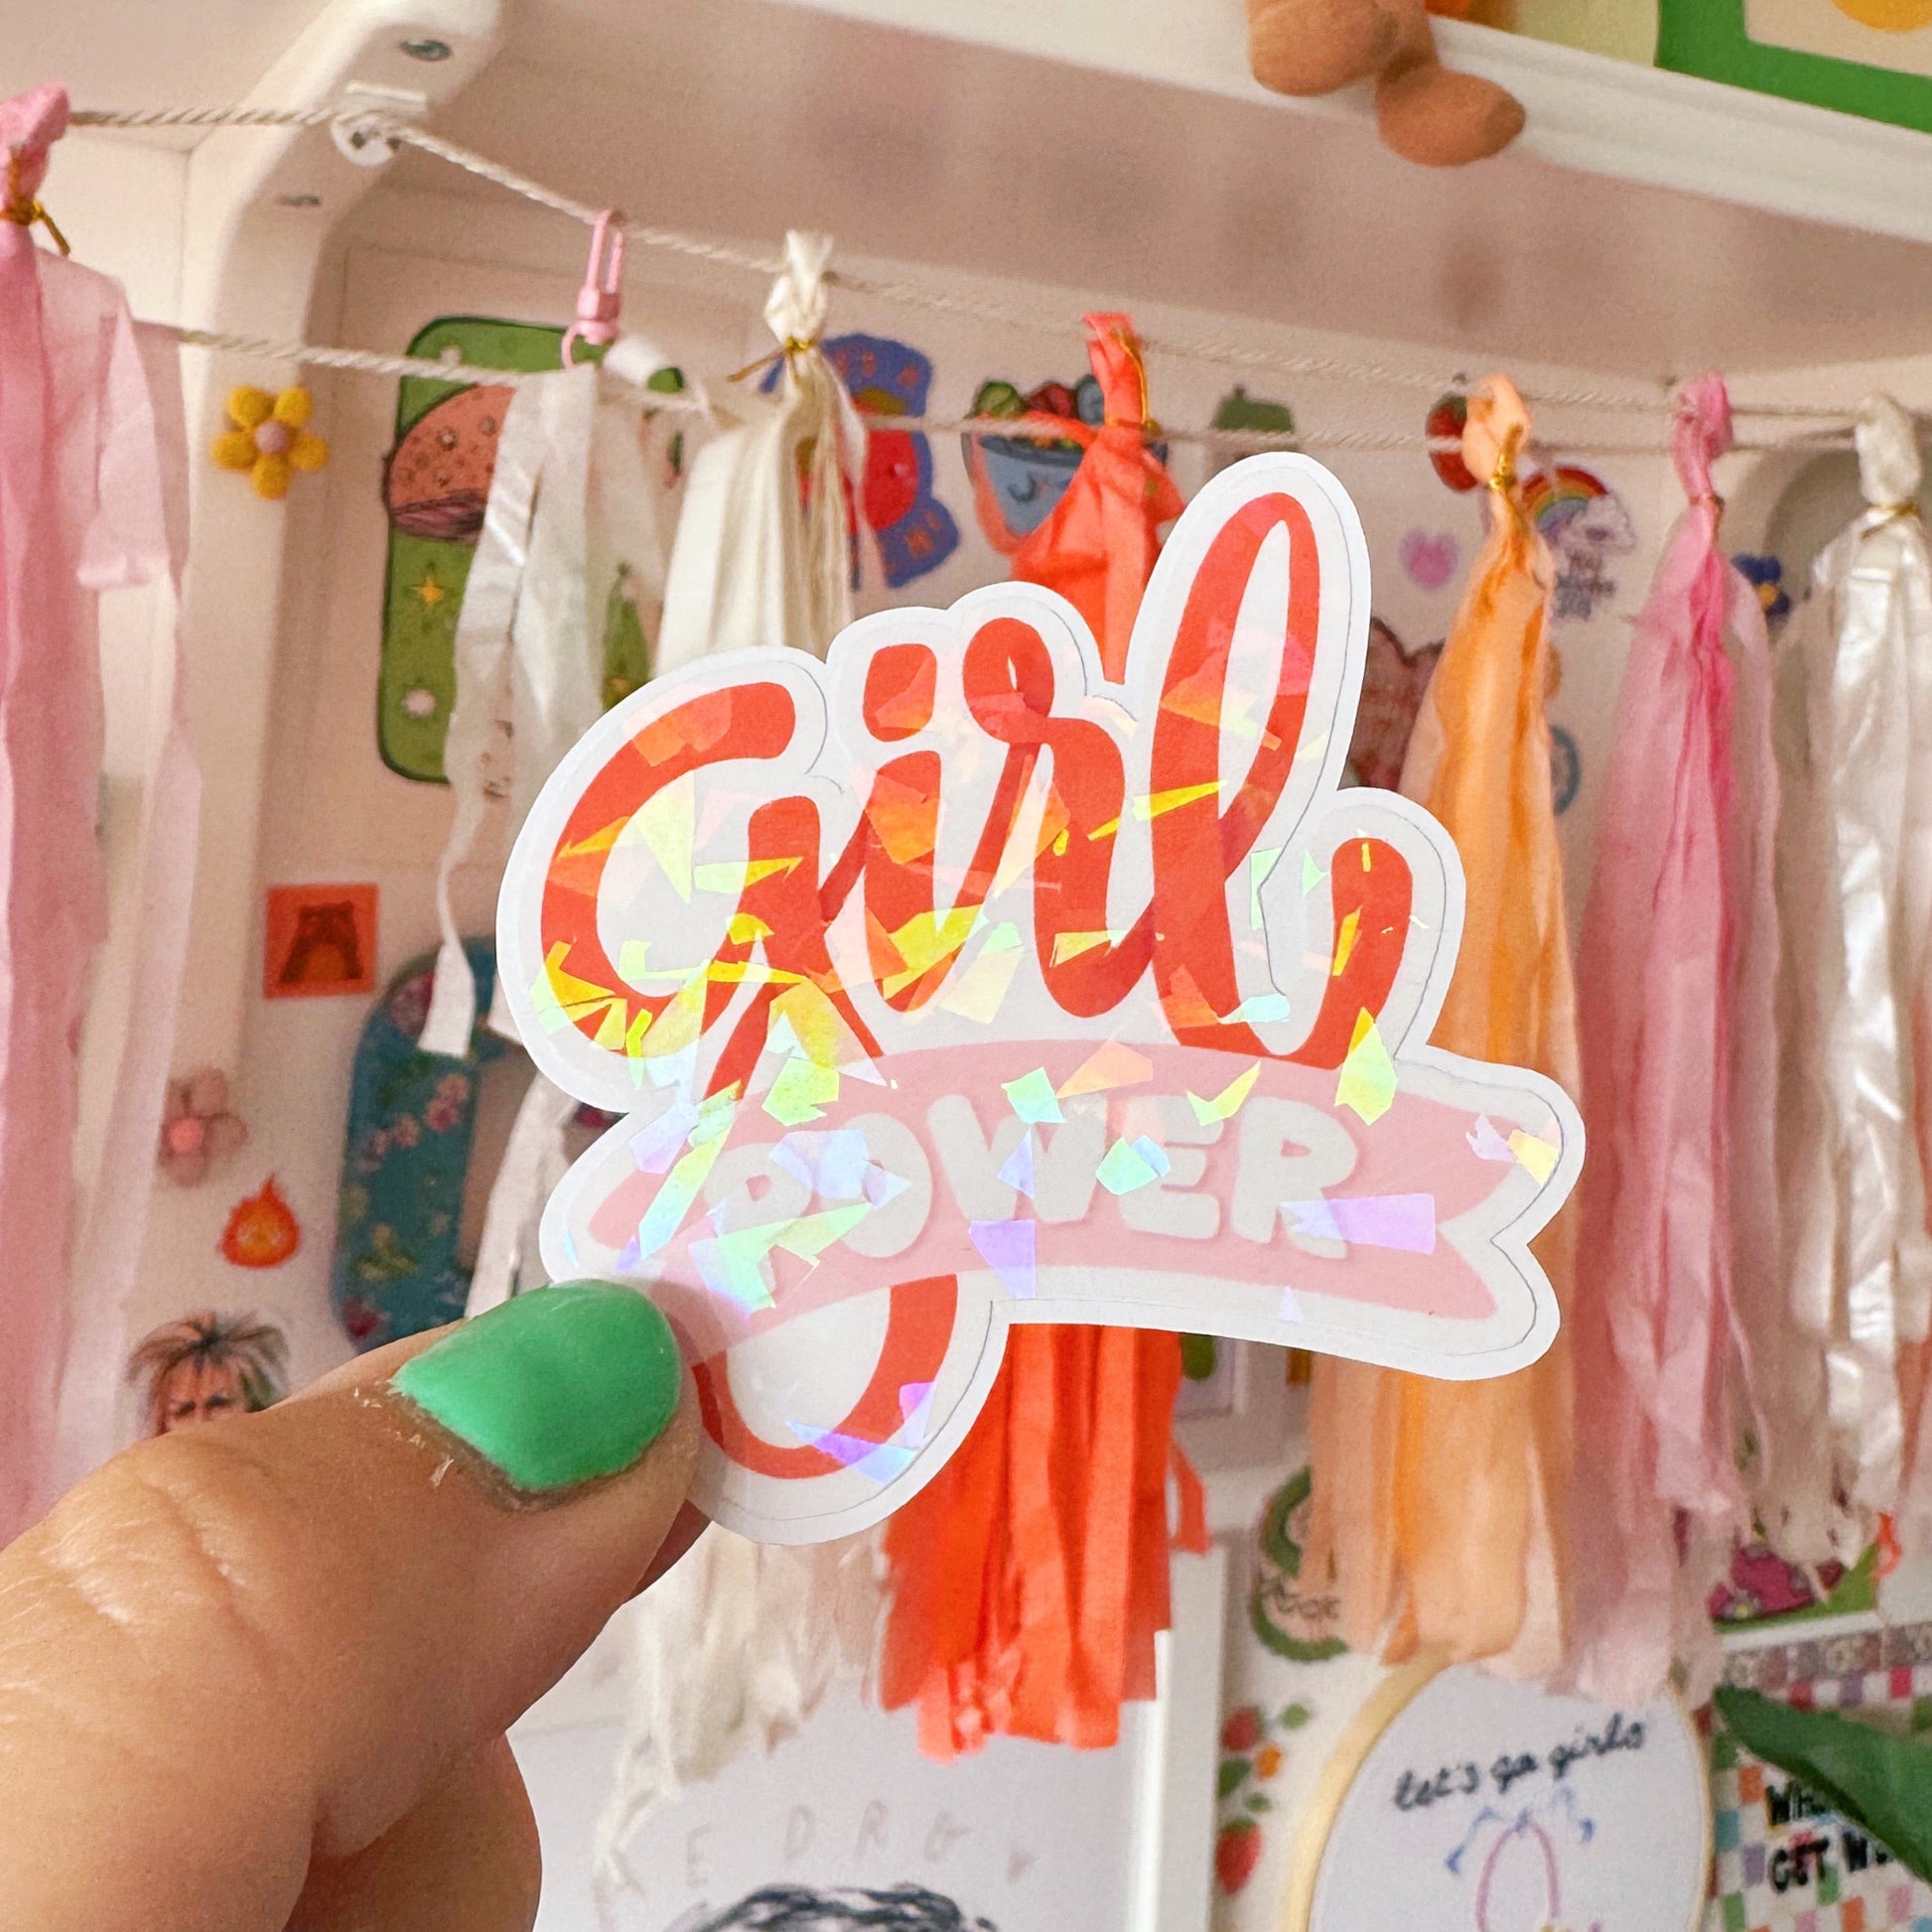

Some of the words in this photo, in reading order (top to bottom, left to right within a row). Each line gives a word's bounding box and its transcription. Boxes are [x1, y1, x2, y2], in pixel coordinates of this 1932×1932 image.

[540, 491, 1413, 1479] Girl
[703, 1094, 1358, 1305] POWER
[1490, 1754, 1538, 1795] go
[1549, 1712, 1644, 1781] girls
[1769, 1838, 1830, 1894] GET
